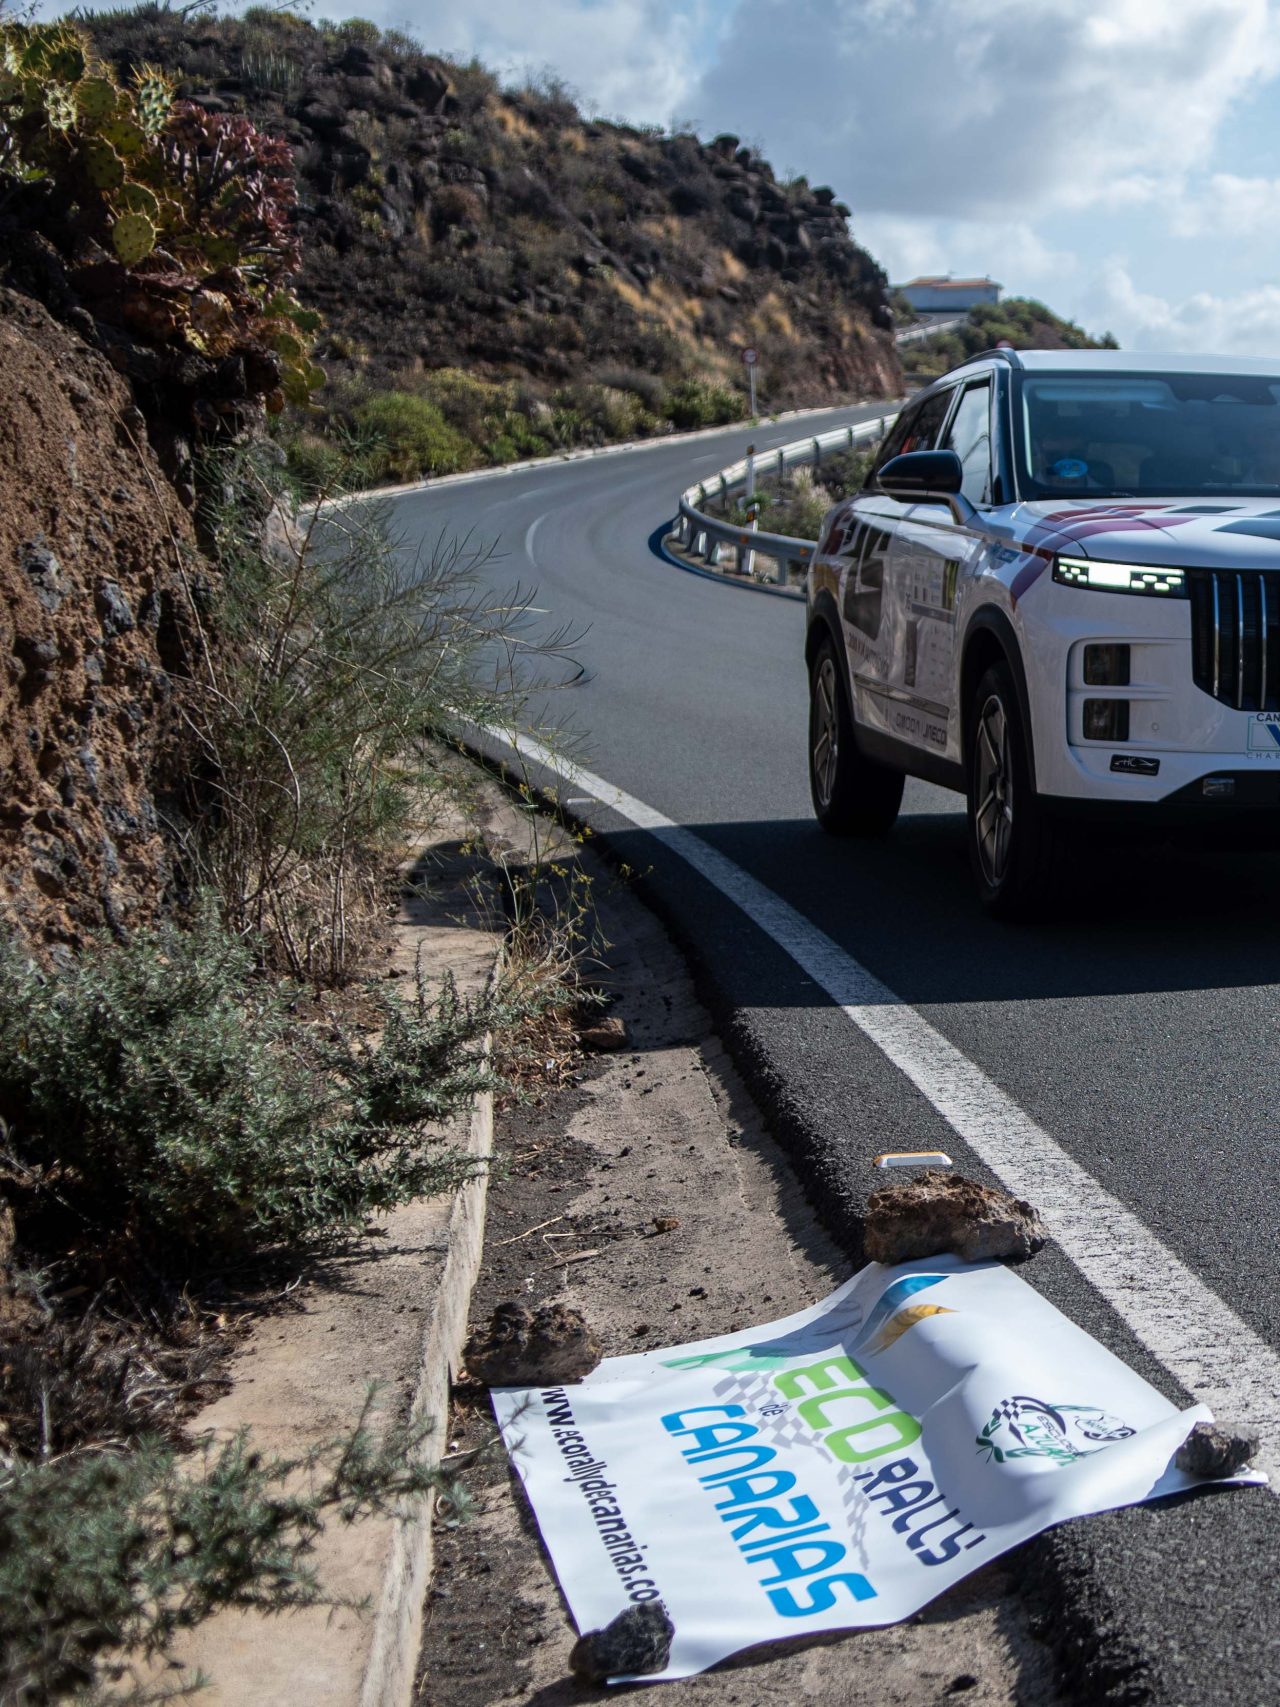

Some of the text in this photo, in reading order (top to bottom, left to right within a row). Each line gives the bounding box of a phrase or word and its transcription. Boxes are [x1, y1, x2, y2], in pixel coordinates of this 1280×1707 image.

[757, 1401, 792, 1417] de
[773, 1355, 922, 1463] ECO
[541, 1387, 669, 1616] ww.ecorallydecanarias.co
[660, 1404, 878, 1618] CANARIAS
